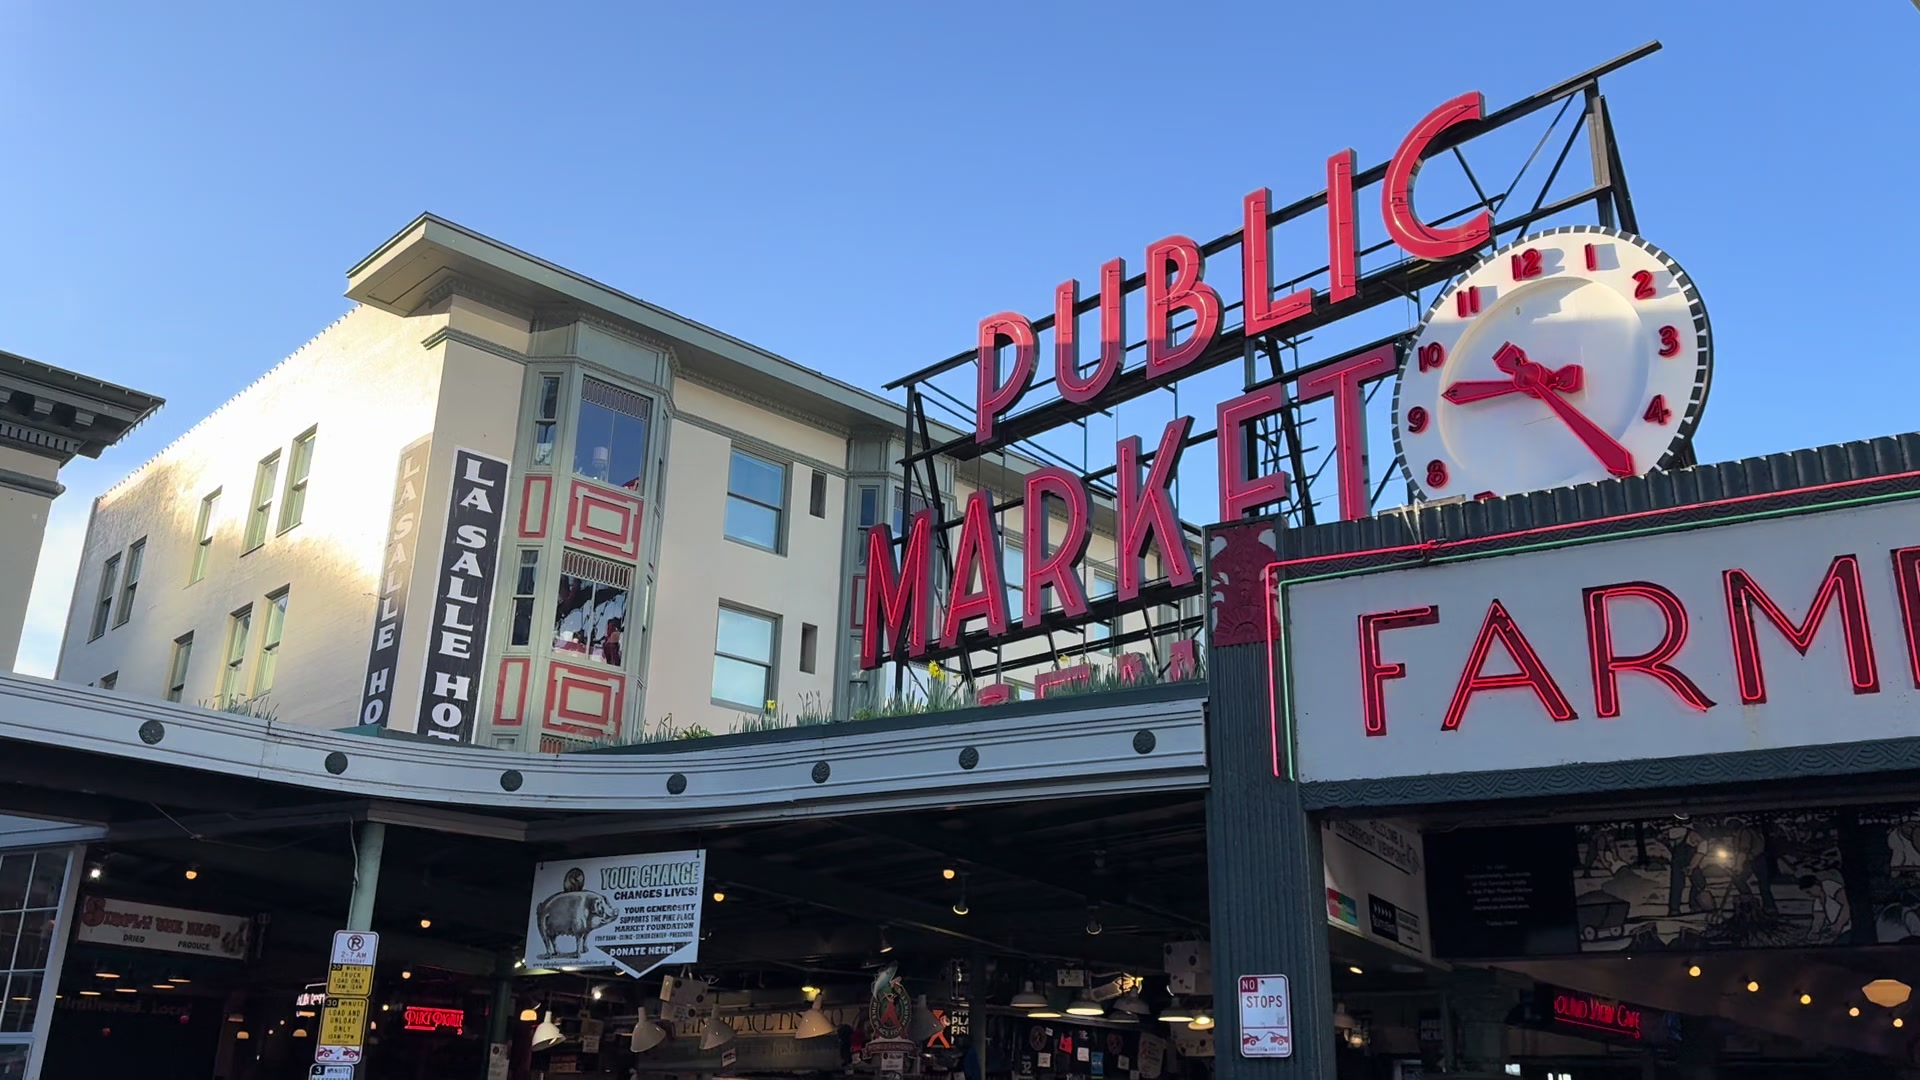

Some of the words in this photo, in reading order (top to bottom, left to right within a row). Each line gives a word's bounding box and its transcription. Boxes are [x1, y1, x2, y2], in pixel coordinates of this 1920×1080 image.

[976, 91, 1494, 444] PUBLIC
[1511, 248, 1542, 281] 12
[1585, 243, 1597, 271] 1
[1632, 270, 1656, 300] 2
[1456, 286, 1479, 318] 11
[1658, 325, 1680, 357] 3
[1418, 341, 1445, 373] 10
[1407, 406, 1429, 433] 9
[1643, 394, 1672, 425] 4
[399, 455, 421, 505] LA
[459, 458, 495, 514] LA
[1426, 459, 1448, 488] 8
[861, 343, 1398, 670] MARKET
[375, 513, 415, 652] SALLE
[438, 524, 488, 660] SALLE
[427, 671, 472, 742] HO
[601, 866, 639, 890] YOUR
[639, 861, 701, 888] CHANGE
[614, 888, 662, 900] CHANGES
[664, 886, 699, 898] LIVES!
[619, 914, 649, 924] SUPPORTS
[650, 914, 661, 922] THE
[662, 914, 675, 922] PIKE
[676, 912, 694, 922] PLACE
[624, 905, 645, 914] YOUR
[646, 903, 696, 913] GENEROSITY
[614, 925, 645, 933] MARKET
[646, 922, 694, 932] FOUNDATION
[122, 934, 146, 944] DRIED
[177, 940, 210, 951] PRODUCE
[609, 945, 646, 956] DONATE
[648, 944, 676, 955] HERE!
[1242, 979, 1255, 990] NO
[1246, 995, 1283, 1008] STOPS
[1554, 995, 1588, 1018] OUND
[777, 1011, 804, 1031] FIS
[951, 1017, 969, 1026] PLA
[951, 1026, 969, 1036] FIS
[315, 1066, 321, 1074] 3
